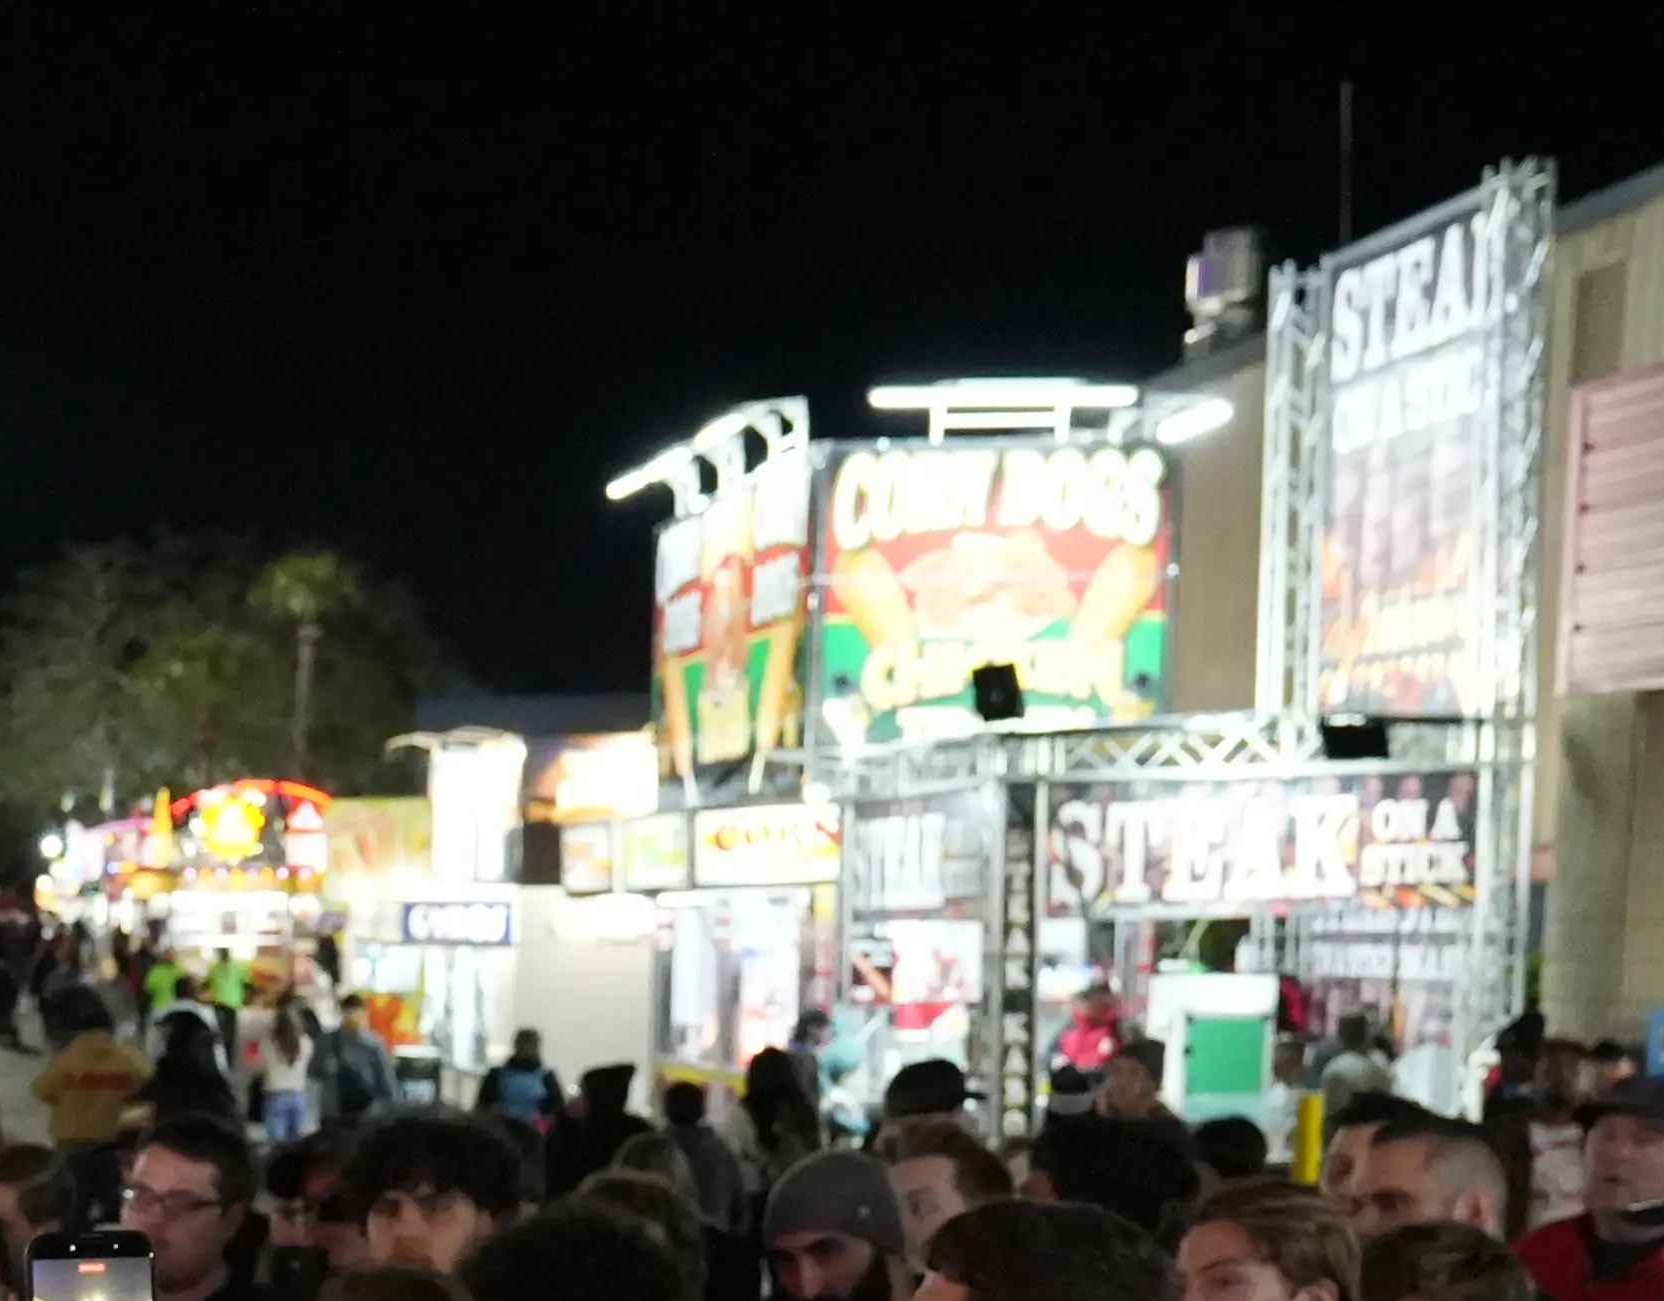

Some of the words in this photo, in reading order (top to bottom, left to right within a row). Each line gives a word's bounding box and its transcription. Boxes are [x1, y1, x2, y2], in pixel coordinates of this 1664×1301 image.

[835, 449, 998, 549] CORN
[999, 446, 1164, 547] DOGS
[1050, 794, 1361, 903] STEAK
[1371, 800, 1428, 841] ON
[1430, 799, 1461, 840] A
[1362, 843, 1468, 886] STICK
